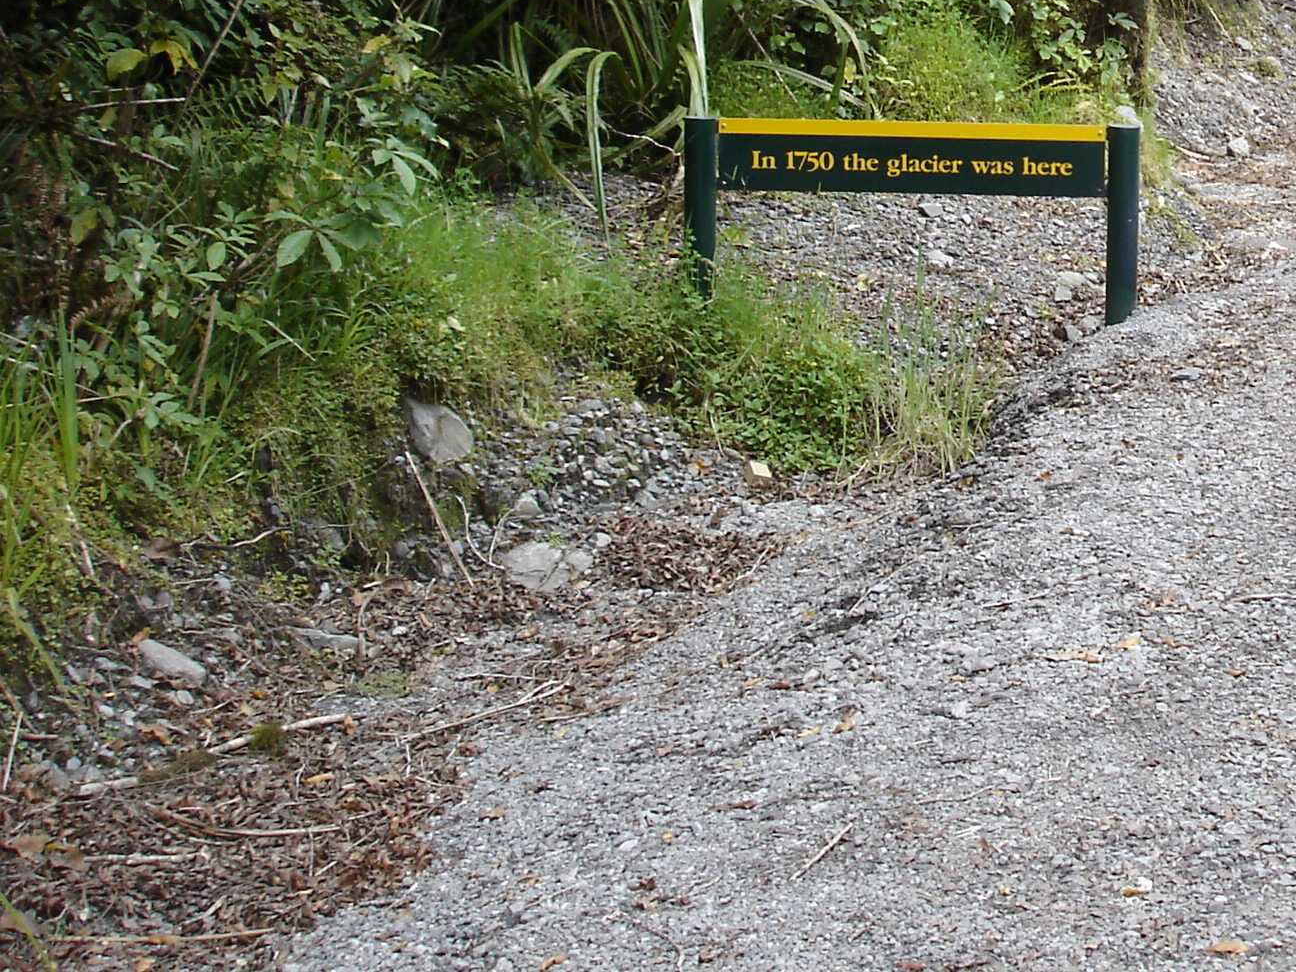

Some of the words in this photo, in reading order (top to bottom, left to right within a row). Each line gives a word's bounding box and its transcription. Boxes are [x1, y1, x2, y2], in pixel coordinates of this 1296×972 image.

[751, 150, 777, 170] In
[786, 150, 835, 172] 1750
[843, 152, 879, 172] the
[886, 153, 963, 177] glacier
[971, 160, 1014, 175] was
[1022, 157, 1073, 176] here
